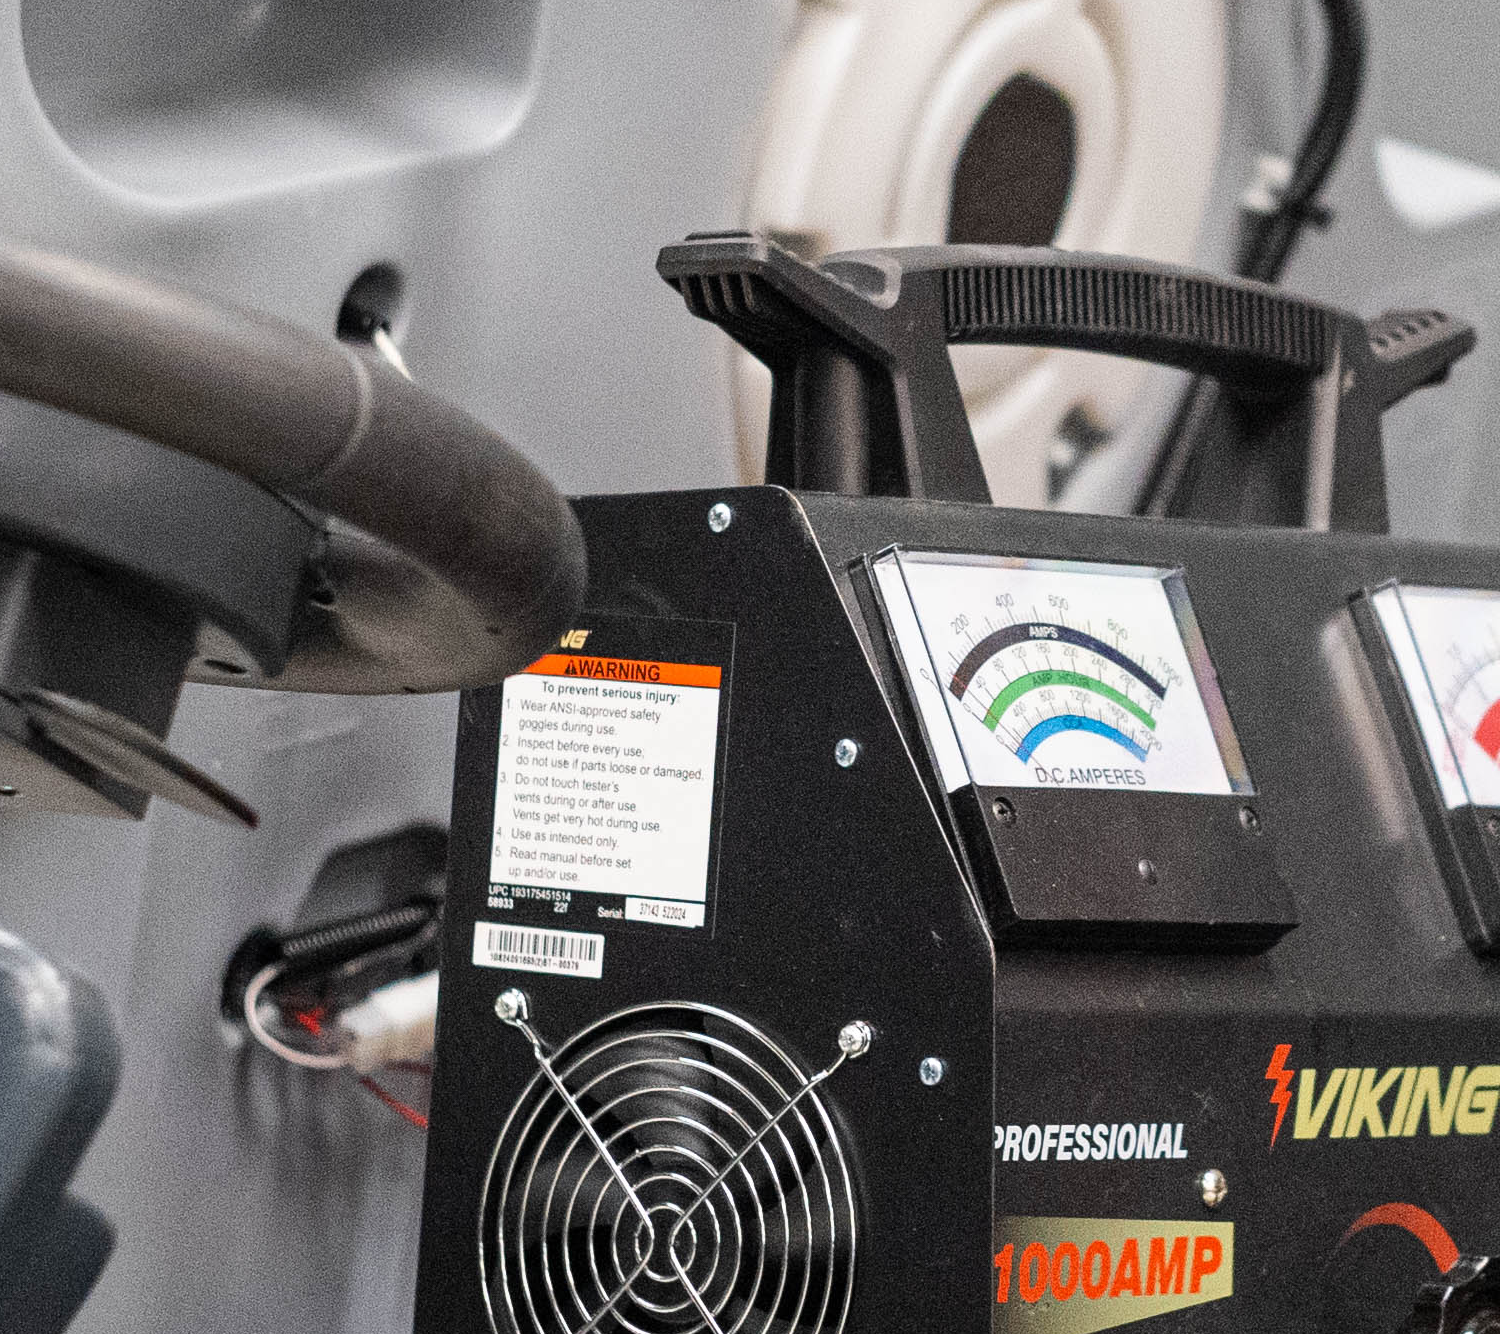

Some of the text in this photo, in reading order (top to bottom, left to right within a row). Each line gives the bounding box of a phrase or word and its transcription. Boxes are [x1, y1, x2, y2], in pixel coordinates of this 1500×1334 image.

[995, 593, 1014, 608] 400
[950, 613, 970, 635] 200
[1029, 626, 1059, 639] AMPS
[579, 660, 661, 681] WARNING
[1032, 672, 1053, 686] AMP
[542, 681, 681, 705] To prevent serious injury:
[519, 699, 547, 712] Wear
[549, 701, 628, 719] ANSI-approved
[630, 709, 662, 723] safety
[519, 719, 558, 733] goggles
[561, 720, 594, 736] during
[517, 737, 554, 752] Inspect
[557, 740, 590, 754] before
[592, 744, 620, 758] every
[516, 755, 529, 765] do
[532, 756, 548, 767] not
[551, 759, 569, 769] use
[572, 758, 579, 770] if
[581, 761, 607, 773] parts
[609, 762, 637, 775] loose
[640, 766, 650, 775] or
[515, 773, 530, 785] Do
[533, 775, 549, 787] not
[551, 776, 579, 790] touch
[582, 779, 620, 793] tester's
[514, 792, 541, 804] vents
[544, 794, 576, 810] during
[578, 797, 589, 807] or
[591, 797, 614, 810] after
[512, 807, 541, 821] Vents
[544, 812, 560, 825] get
[563, 815, 584, 827] very
[587, 813, 603, 827] hot
[607, 817, 638, 832] during
[511, 827, 531, 840] Use
[534, 831, 546, 841] as
[550, 832, 593, 846] intended
[596, 836, 620, 851] only.
[510, 846, 537, 860] Read
[539, 849, 577, 864] manual
[580, 852, 613, 867] before
[615, 857, 632, 869] set
[508, 867, 521, 878] up
[524, 866, 556, 880] and/or
[488, 884, 509, 896] UPC
[994, 1235, 1223, 1303] 1000AMP
